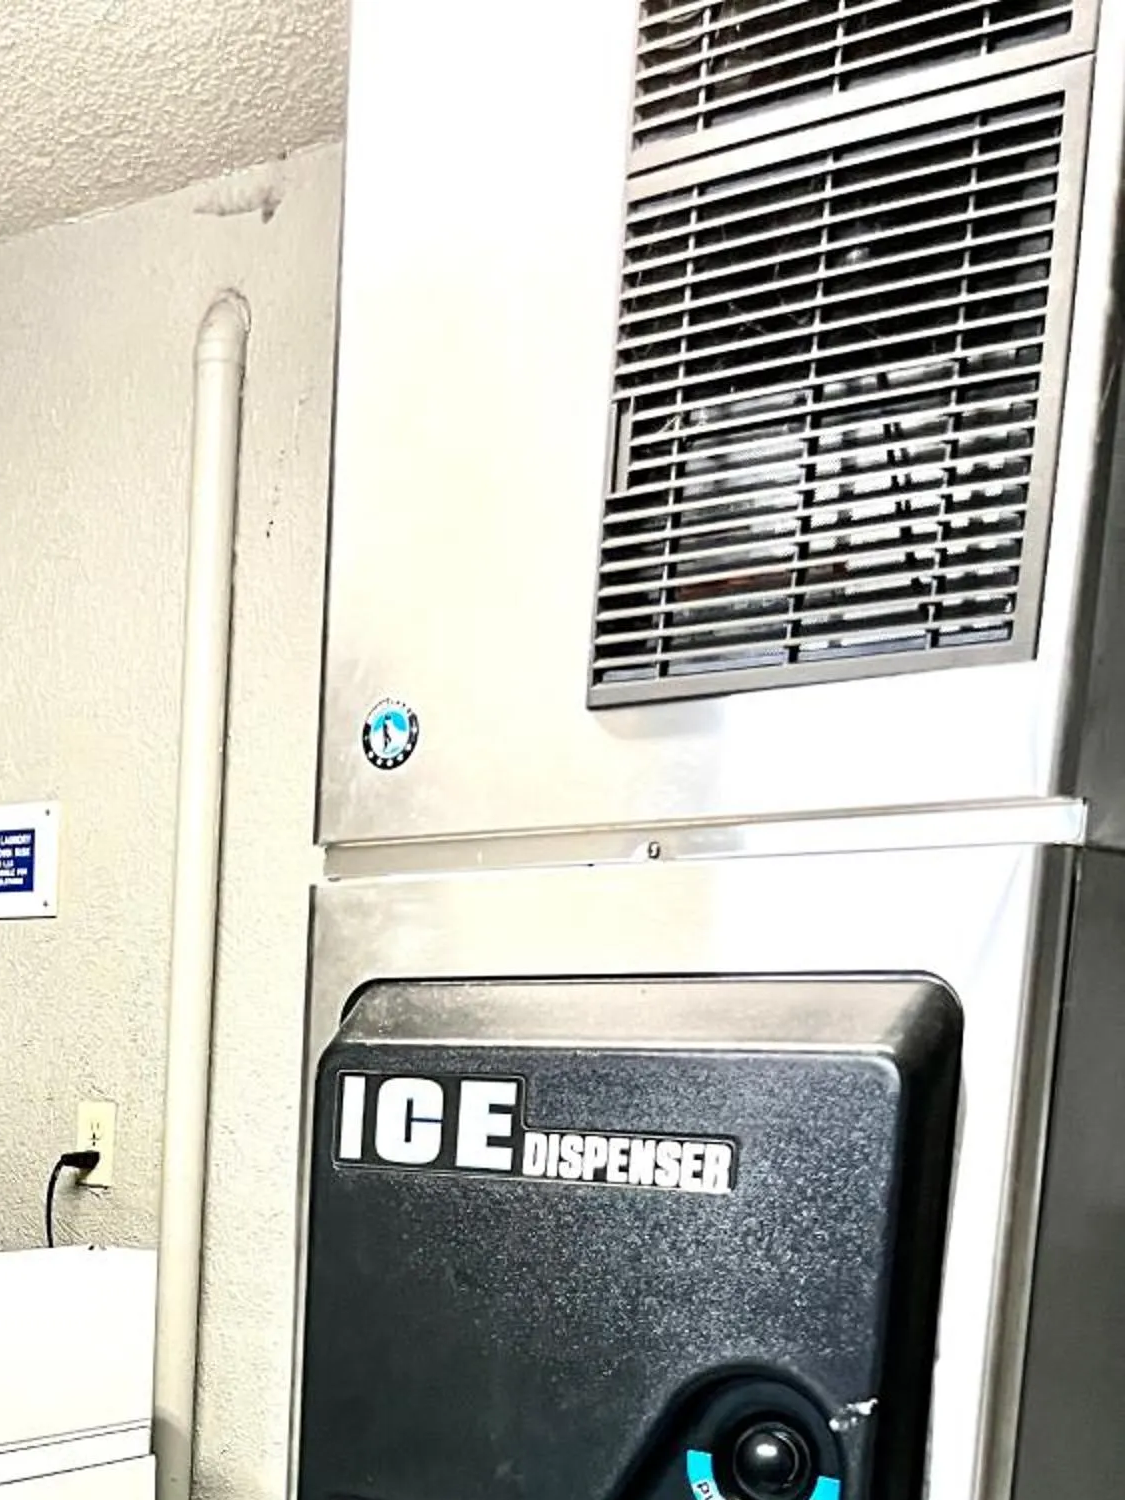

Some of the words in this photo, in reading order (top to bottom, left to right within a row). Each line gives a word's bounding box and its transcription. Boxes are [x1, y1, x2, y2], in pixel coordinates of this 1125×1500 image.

[0, 833, 31, 846] LAUNDRY
[338, 1074, 519, 1171] ICE
[522, 1131, 734, 1194] DISPENSER
